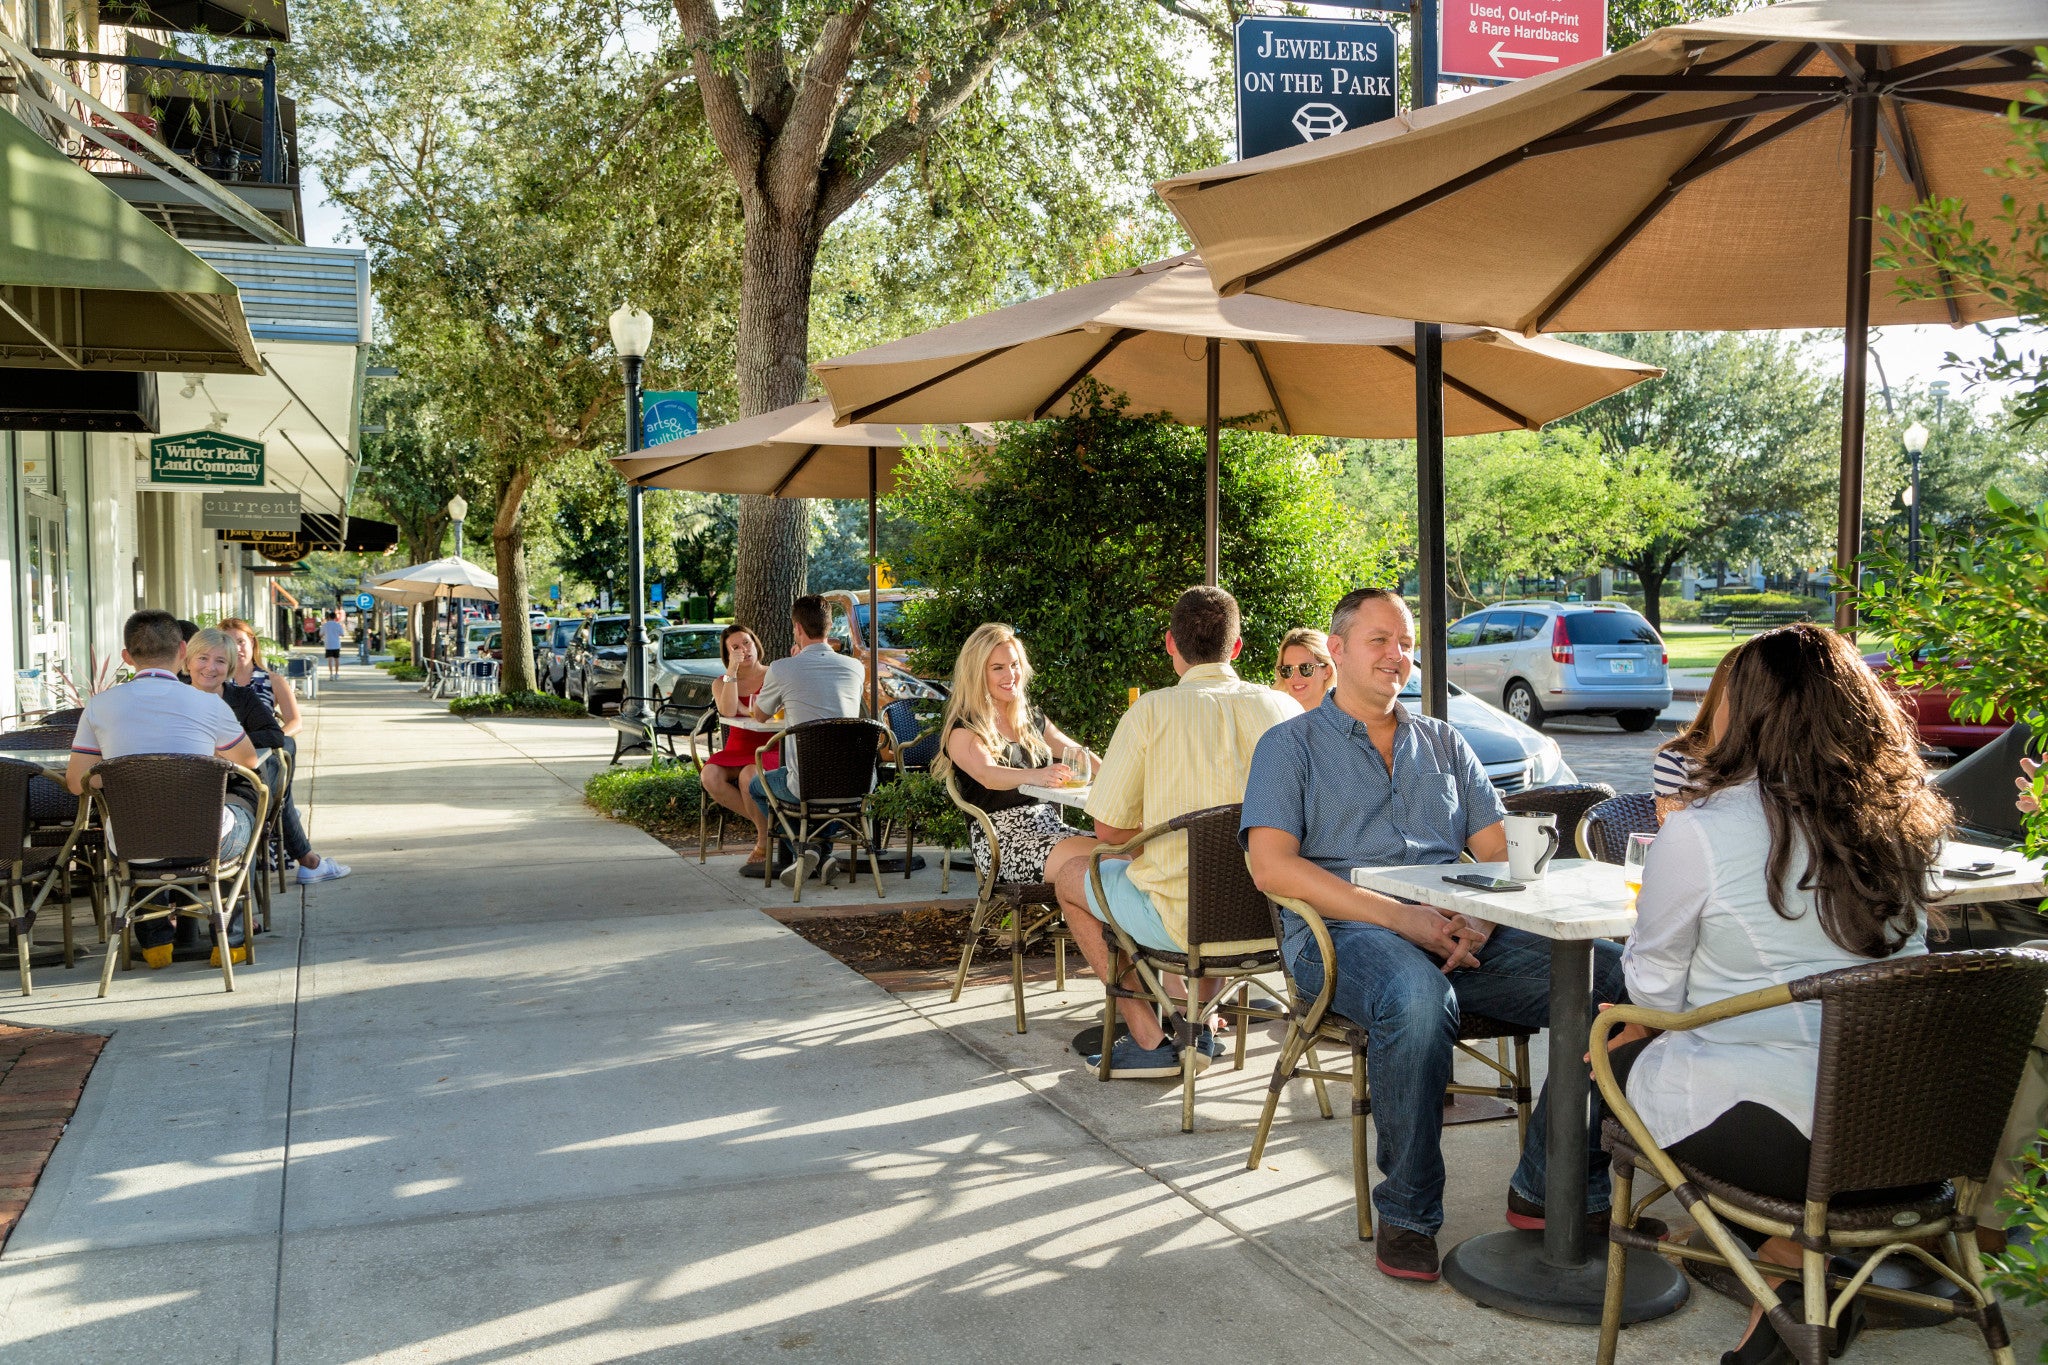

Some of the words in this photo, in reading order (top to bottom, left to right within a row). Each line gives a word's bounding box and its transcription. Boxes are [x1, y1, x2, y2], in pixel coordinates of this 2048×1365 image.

[1470, 3, 1505, 21] Used,
[1508, 6, 1579, 27] Out-of-Print
[1469, 20, 1478, 34] &
[1482, 21, 1510, 37] Rare
[1514, 25, 1579, 44] Hardbacks
[1257, 30, 1378, 63] JEWELERS
[1244, 71, 1275, 93] ON
[1280, 73, 1323, 94] THE
[1330, 67, 1391, 97] PARK
[648, 428, 691, 447] culture
[165, 444, 215, 459] Winter
[216, 447, 250, 461] Park
[154, 457, 193, 471] Land
[193, 459, 261, 477] Company
[204, 500, 298, 514] current
